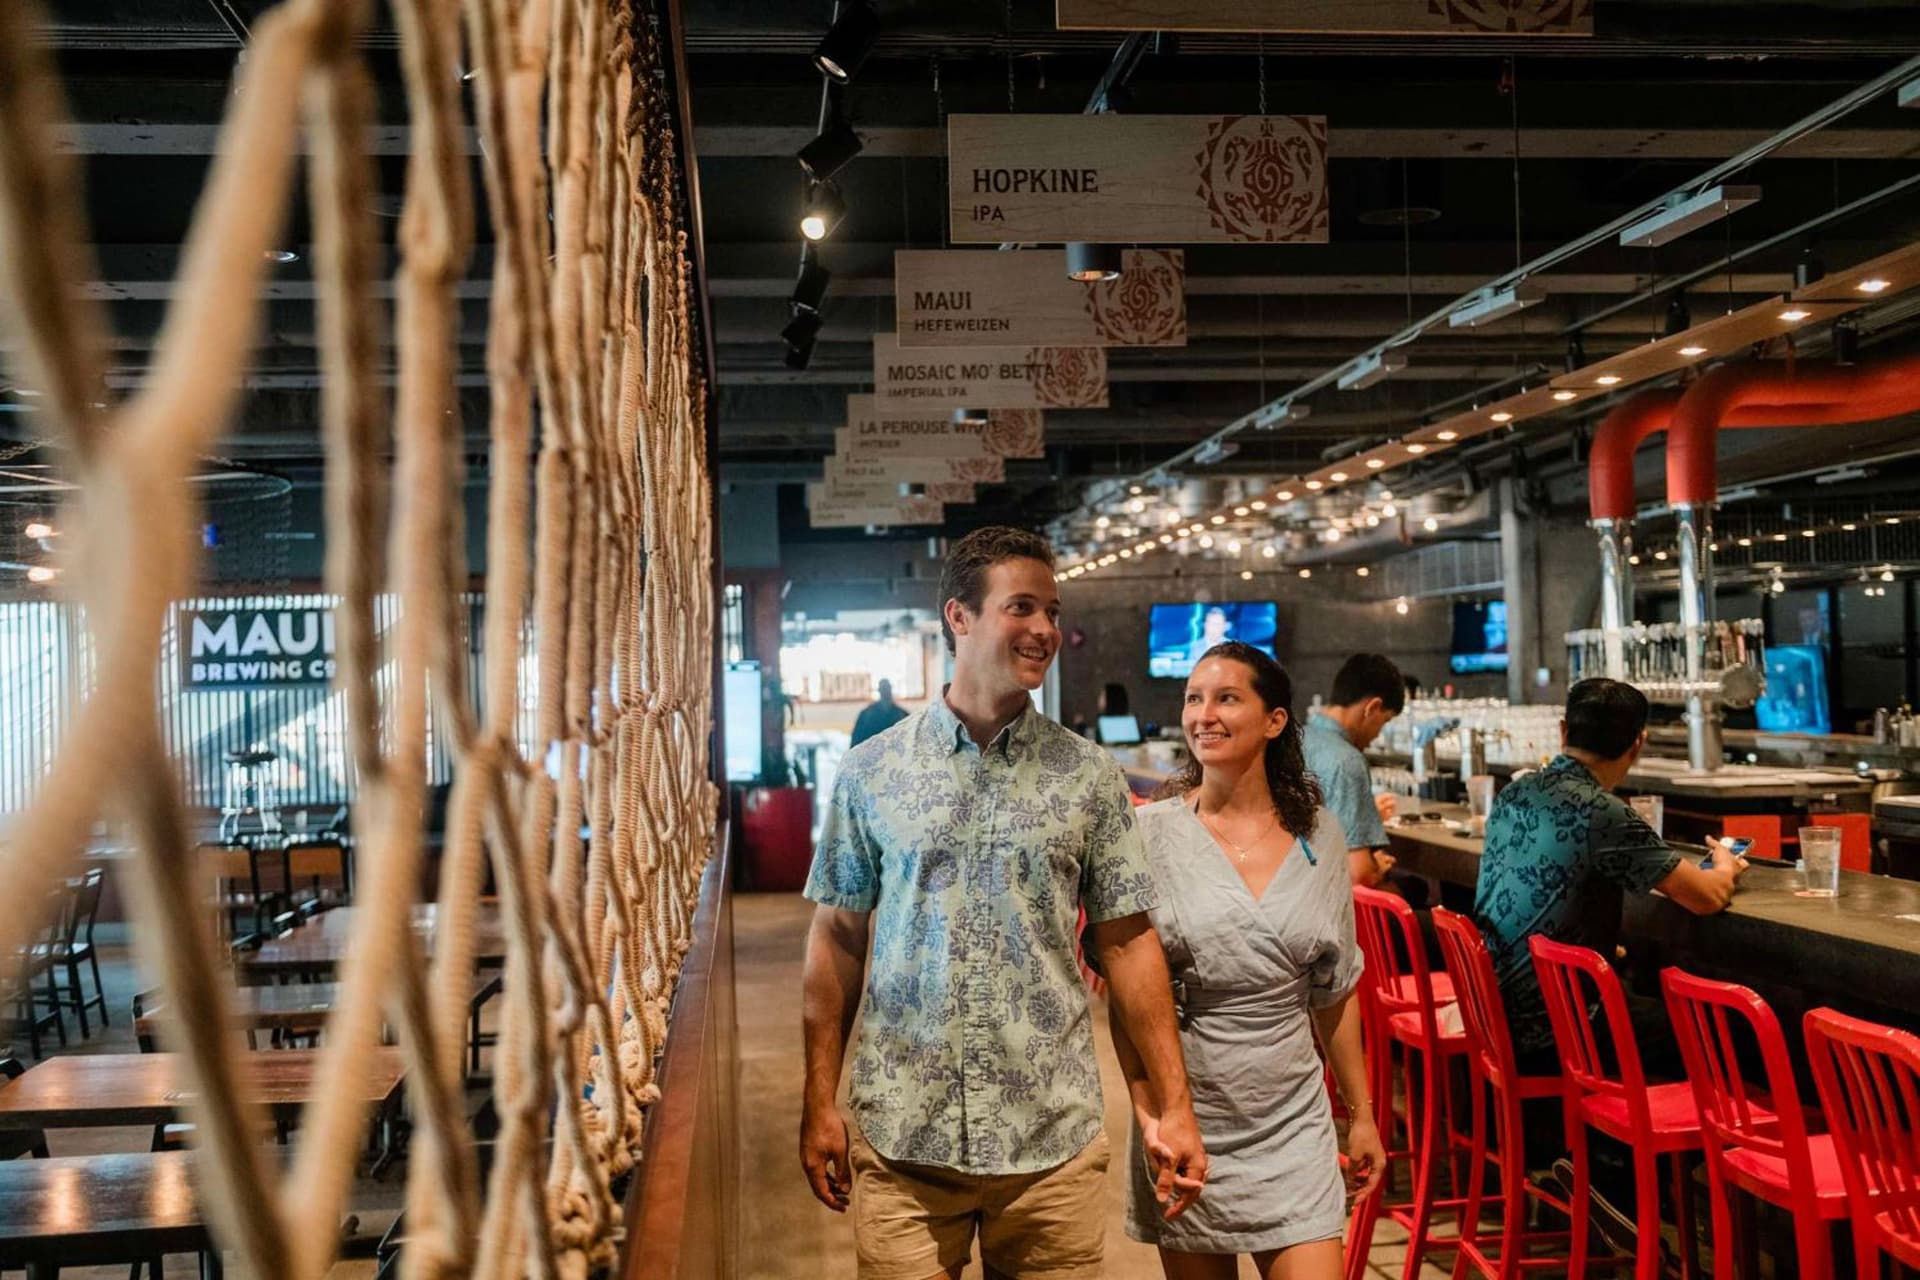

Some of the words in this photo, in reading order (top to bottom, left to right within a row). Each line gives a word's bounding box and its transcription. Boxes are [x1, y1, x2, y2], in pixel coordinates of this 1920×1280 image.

[972, 168, 1099, 194] HOPKINE
[972, 205, 1005, 222] IPA
[914, 291, 972, 311] MAUI
[914, 319, 1010, 332] HEFEWEIZEN
[888, 364, 956, 381] MOSAIC
[999, 362, 1055, 381] BETTA
[888, 386, 945, 398] IMPERIAL
[947, 386, 968, 397] IPA
[859, 420, 877, 434] LA
[882, 419, 949, 435] PEROUSE
[191, 612, 336, 657] MAUI
[191, 660, 303, 682] BREWING
